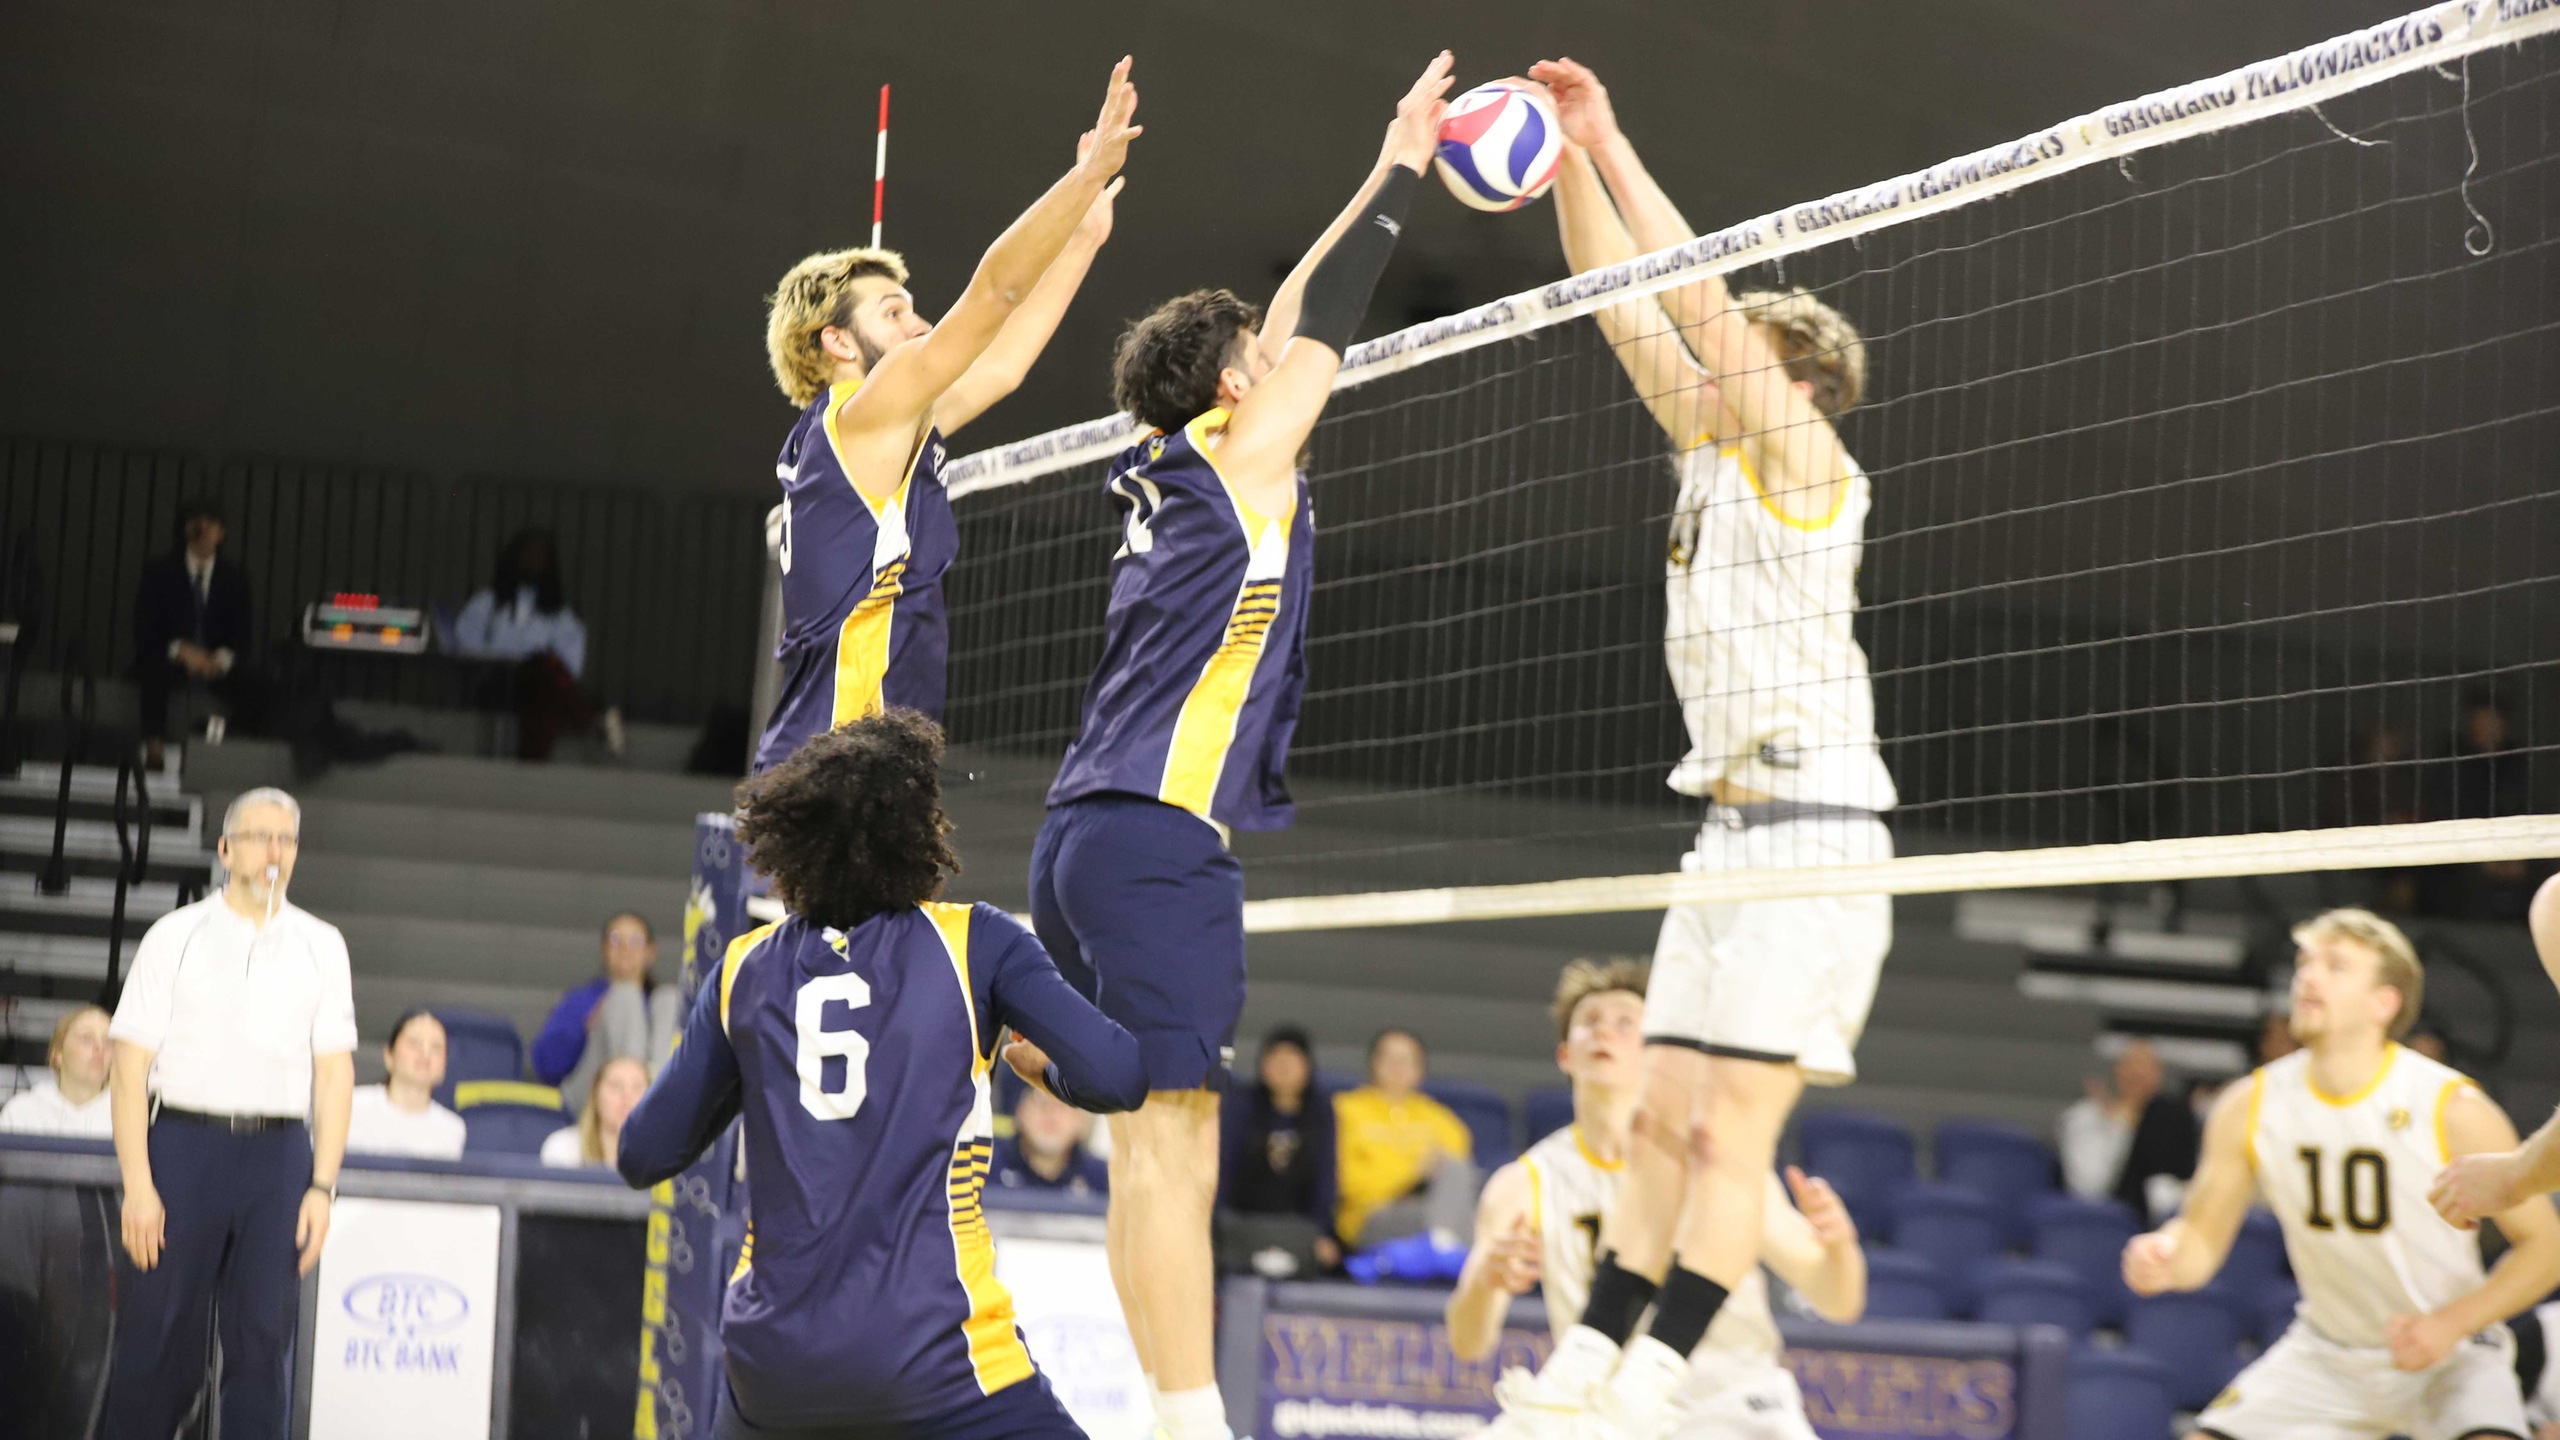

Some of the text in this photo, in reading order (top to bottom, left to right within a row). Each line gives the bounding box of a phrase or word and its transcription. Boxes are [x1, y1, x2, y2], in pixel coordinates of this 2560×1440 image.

[2104, 16, 2445, 138] GRACELAND YELLOWJACKETS
[795, 972, 871, 1121] 6
[2297, 1147, 2390, 1234] 10
[378, 1281, 437, 1320] BTC
[395, 1339, 461, 1374] BANK
